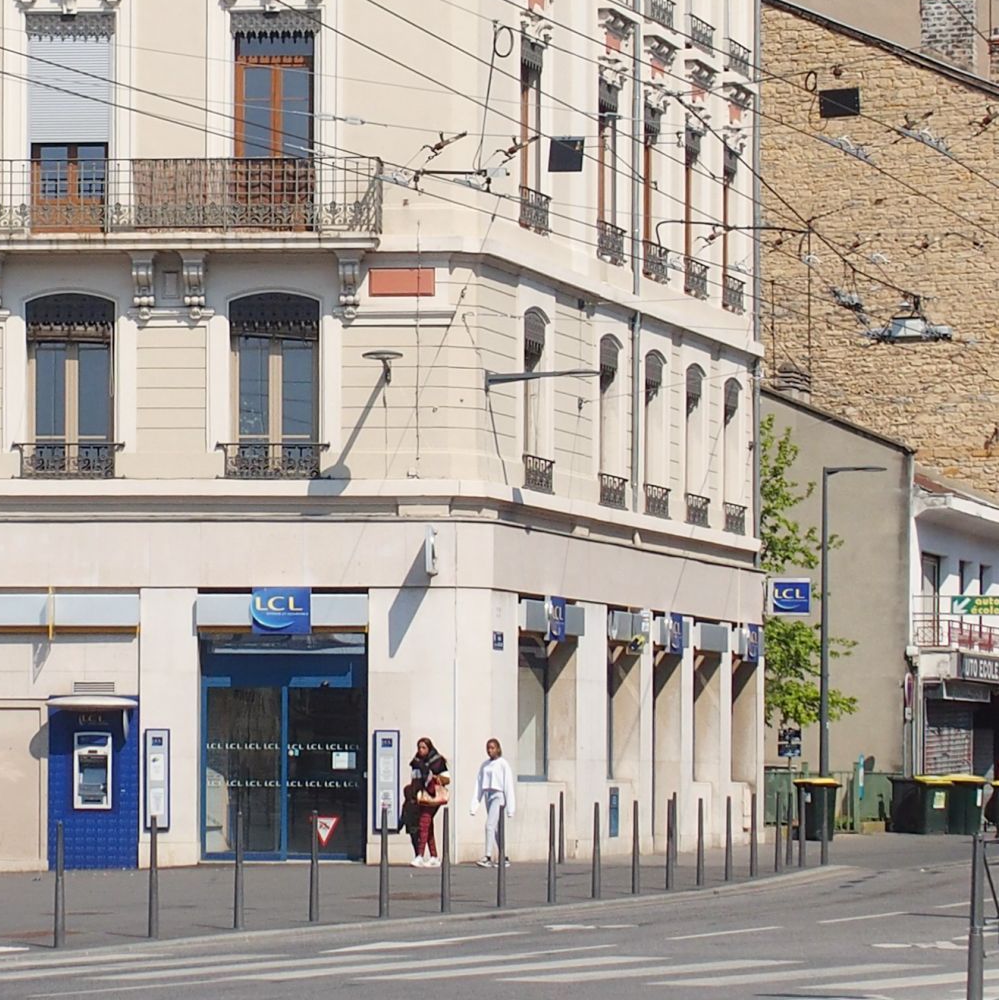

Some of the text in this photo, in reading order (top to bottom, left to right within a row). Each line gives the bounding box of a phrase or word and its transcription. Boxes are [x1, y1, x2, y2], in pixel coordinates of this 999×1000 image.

[774, 588, 805, 599] LCL
[255, 596, 303, 611] LCL
[975, 597, 999, 606] auto
[970, 605, 999, 614] école
[979, 659, 999, 679] ECOLE
